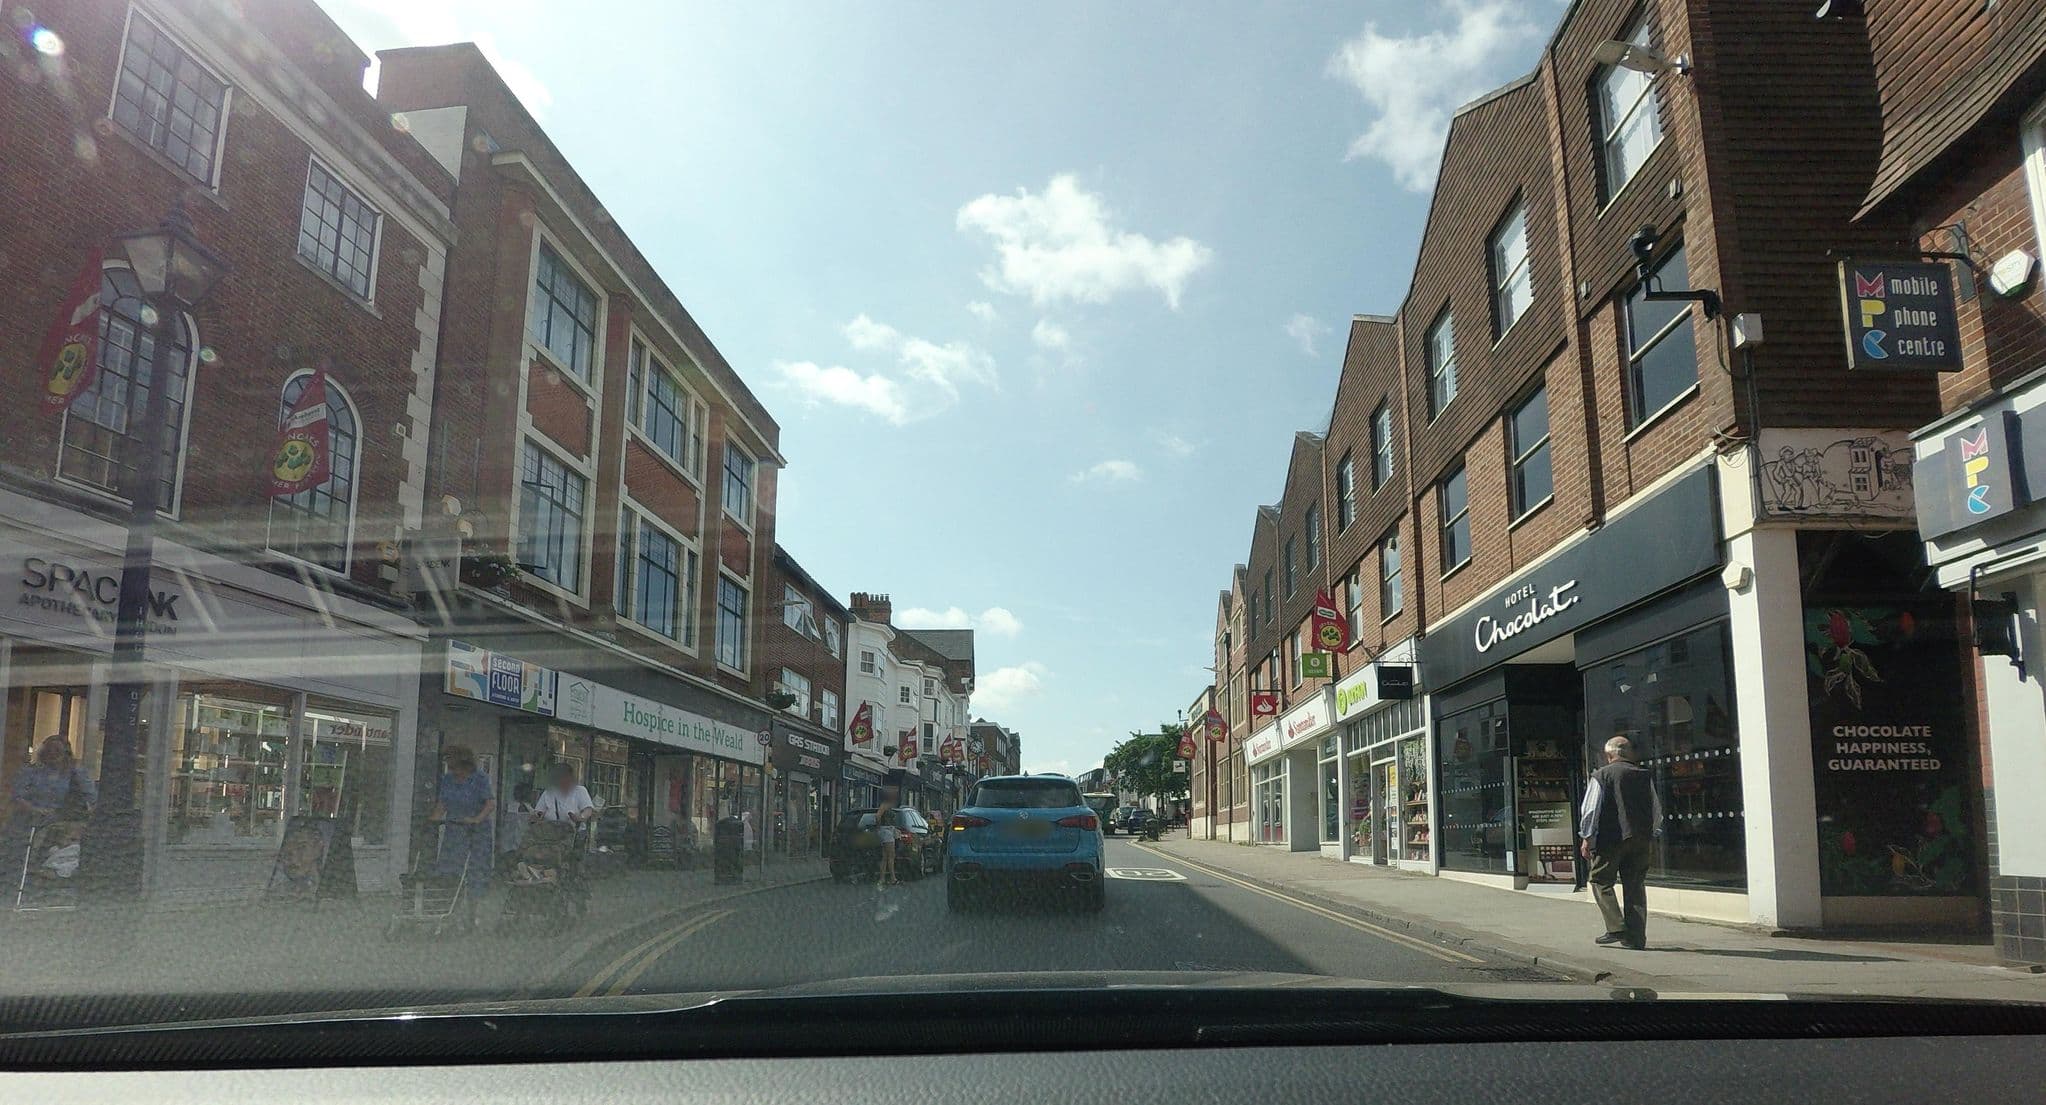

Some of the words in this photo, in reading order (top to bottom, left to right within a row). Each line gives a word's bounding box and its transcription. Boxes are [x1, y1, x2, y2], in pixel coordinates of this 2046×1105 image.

[1891, 277, 1938, 296] mobile
[1894, 307, 1937, 328] phone
[1898, 337, 1945, 356] centre
[1505, 583, 1535, 609] HOTEL
[492, 671, 520, 695] FLOOR
[623, 700, 674, 734] Hospice
[678, 717, 690, 738] in
[693, 722, 711, 743] the
[713, 727, 743, 751] Weald
[1833, 725, 1932, 738] CHOCOLATE
[760, 733, 769, 741] 20
[788, 734, 804, 748] GAS
[1836, 742, 1932, 756] HAPPINESS,
[1828, 759, 1942, 771] GUARANTEED
